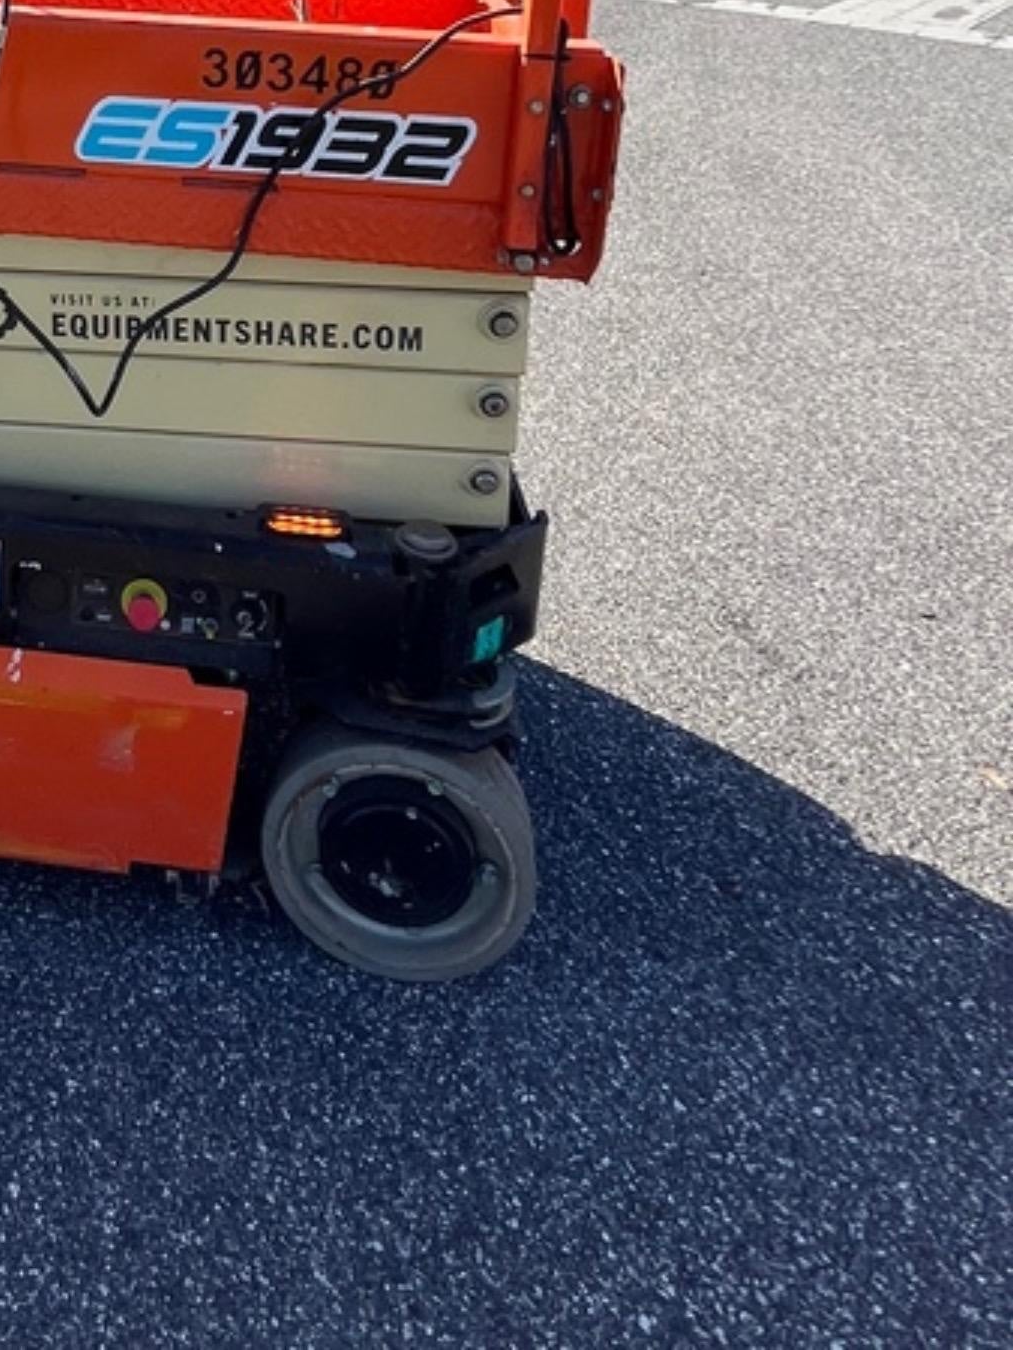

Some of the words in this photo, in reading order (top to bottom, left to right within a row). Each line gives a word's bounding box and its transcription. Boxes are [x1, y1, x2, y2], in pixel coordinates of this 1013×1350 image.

[202, 47, 397, 100] 303480
[77, 98, 476, 184] ES1932
[50, 293, 94, 307] VISIT
[102, 295, 123, 308] US
[51, 311, 424, 352] EQUIPMENTSHARE.COM
